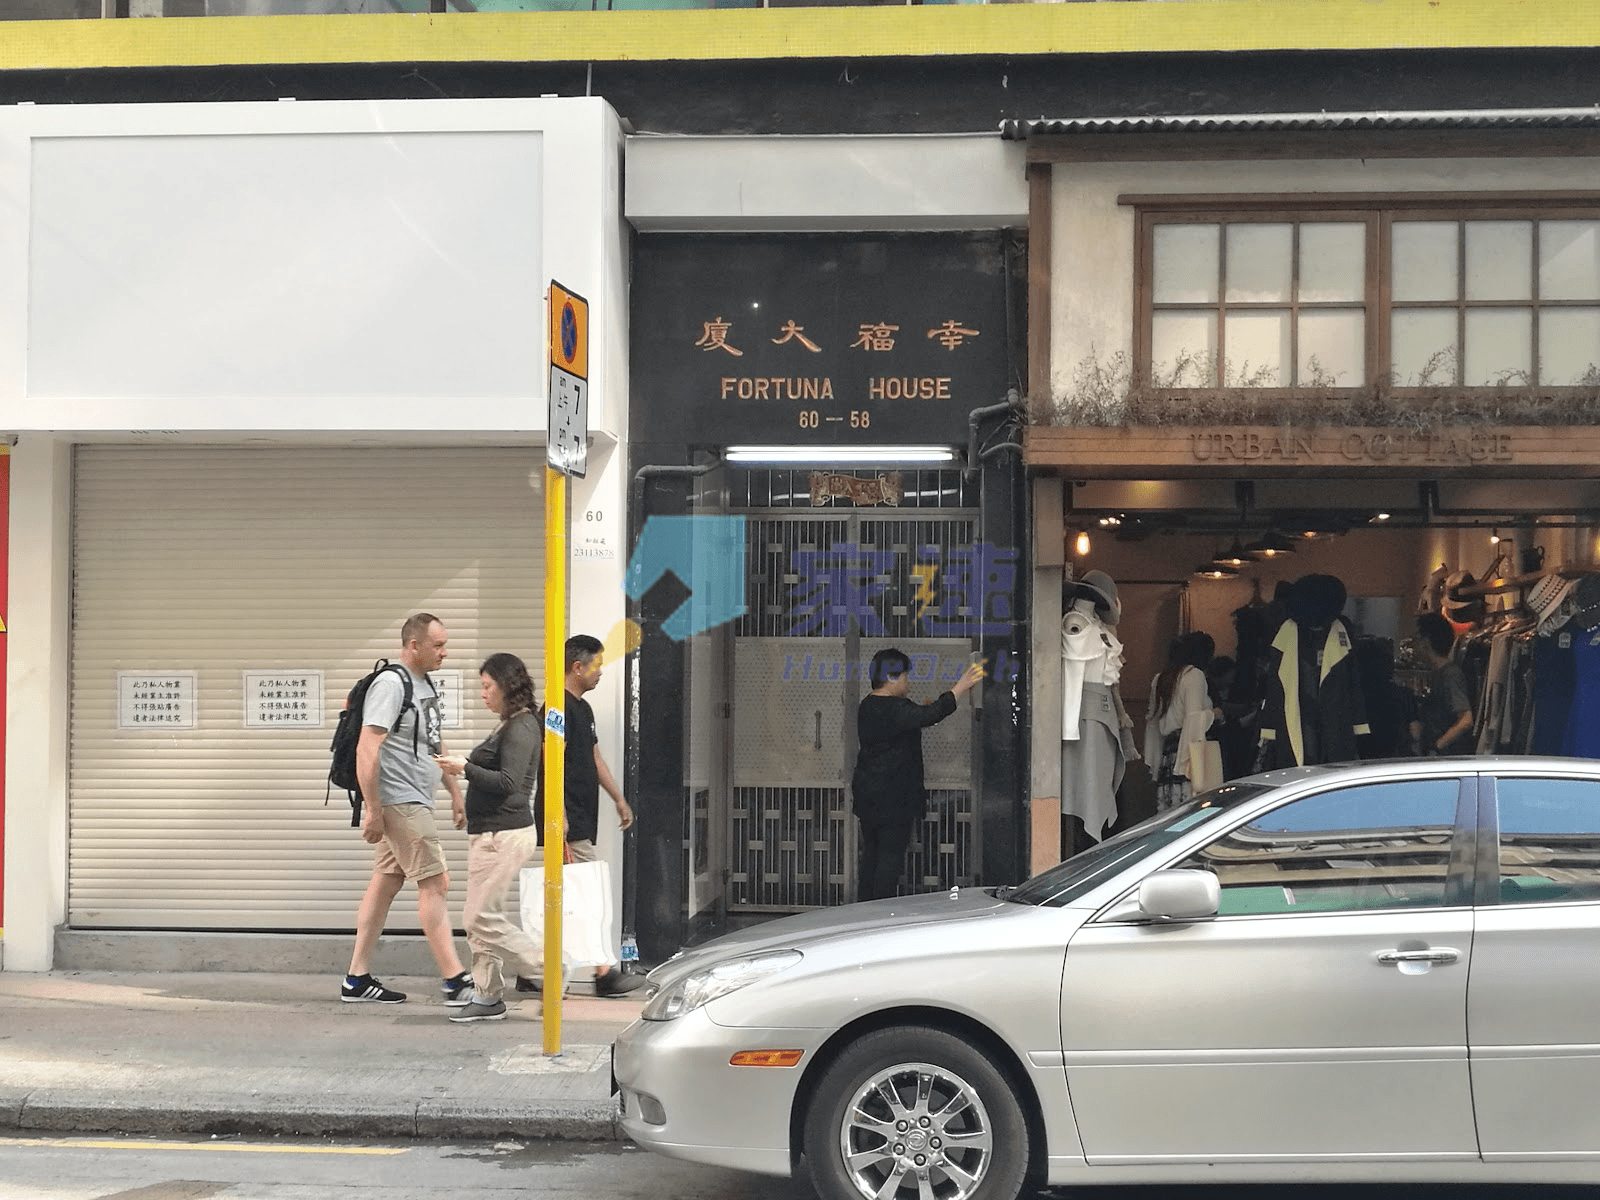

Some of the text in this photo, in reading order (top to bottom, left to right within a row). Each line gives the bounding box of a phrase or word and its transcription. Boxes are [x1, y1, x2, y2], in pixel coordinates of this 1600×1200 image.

[573, 384, 581, 415] 7
[720, 376, 952, 400] FORTUNA HOUSE
[799, 410, 819, 428] 60
[850, 410, 871, 428] 58
[573, 435, 581, 465] 7
[1190, 432, 1514, 462] URBAN COTTAGE
[586, 510, 603, 522] 60
